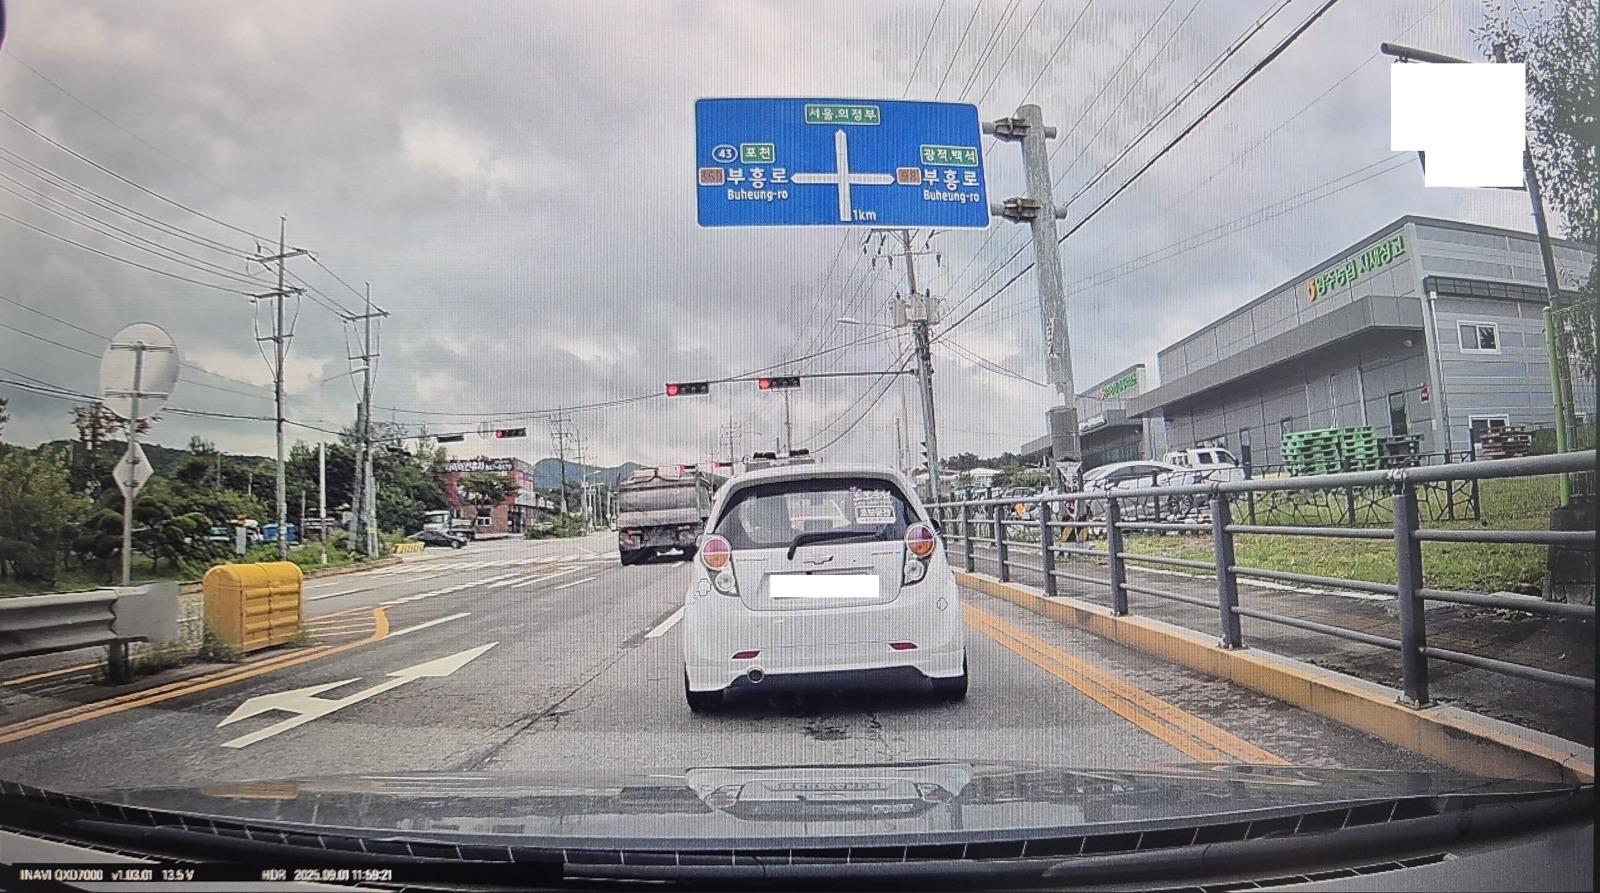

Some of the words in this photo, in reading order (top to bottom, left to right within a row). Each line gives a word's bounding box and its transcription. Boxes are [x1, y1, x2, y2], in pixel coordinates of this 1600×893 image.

[718, 148, 732, 159] 43
[745, 146, 771, 160] 포천
[727, 167, 788, 189] 부흥로
[923, 169, 980, 191] 부흥로
[727, 189, 789, 201] Buheung-ro
[923, 189, 980, 204] Buheung-ro
[852, 209, 877, 221] 1km
